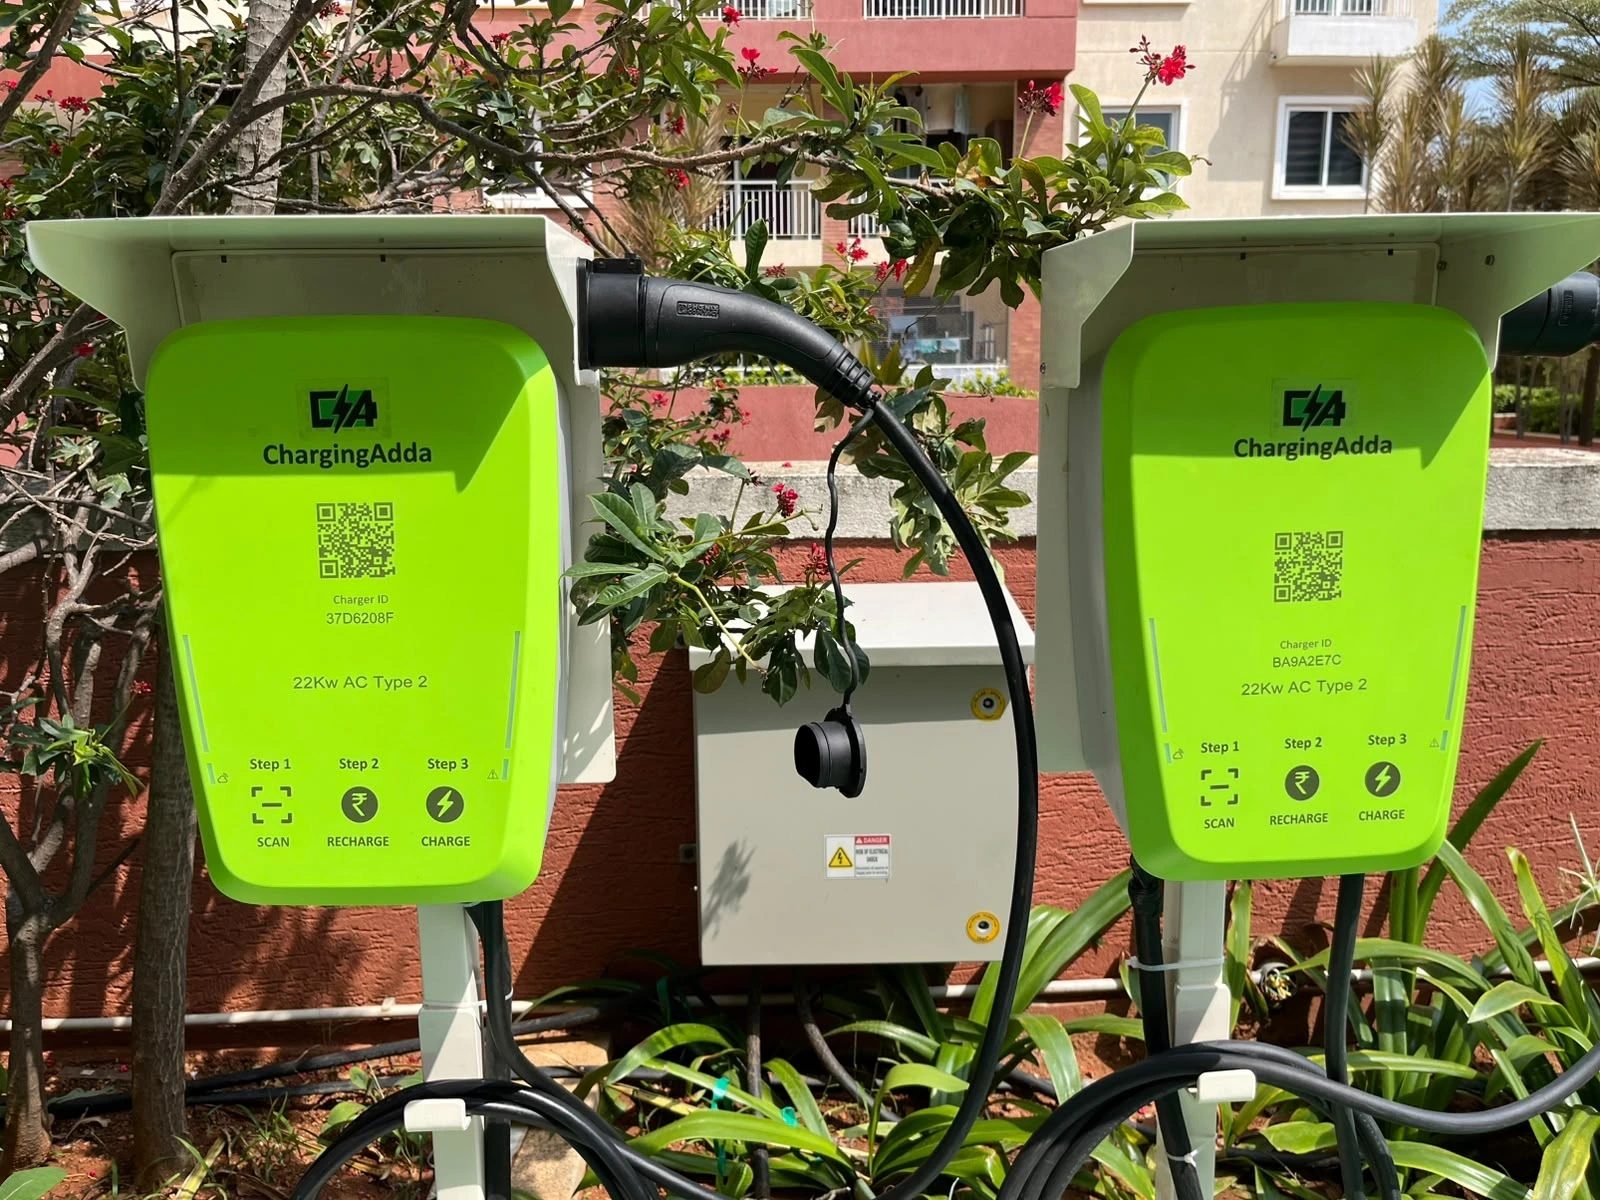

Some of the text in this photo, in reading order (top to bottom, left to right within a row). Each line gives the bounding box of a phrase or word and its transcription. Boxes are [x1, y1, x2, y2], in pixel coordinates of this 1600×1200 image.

[1234, 435, 1393, 461] ChargingAdda
[263, 442, 432, 469] ChargingAdda
[333, 594, 389, 606] Charger ID
[326, 612, 394, 624] 37D6208F
[1280, 639, 1332, 650] Charger ID
[1272, 654, 1341, 668] BA9A2E7C
[293, 675, 428, 691] 22Kw AC Type 2
[1241, 678, 1368, 696] 22Kw AC Type 2
[1284, 737, 1323, 750] Step 2
[1368, 733, 1407, 748] Step 3
[1201, 741, 1240, 755] Step 1
[250, 758, 291, 772] Step 1
[339, 758, 379, 772] Step 2
[427, 758, 469, 772] Step 3
[1269, 813, 1329, 825] RECHARGE
[1358, 809, 1406, 821] CHARGE
[1204, 818, 1235, 829] SCAN
[257, 837, 290, 848] SCAN
[327, 836, 389, 847] RECHARGE
[421, 836, 471, 847] CHARGE
